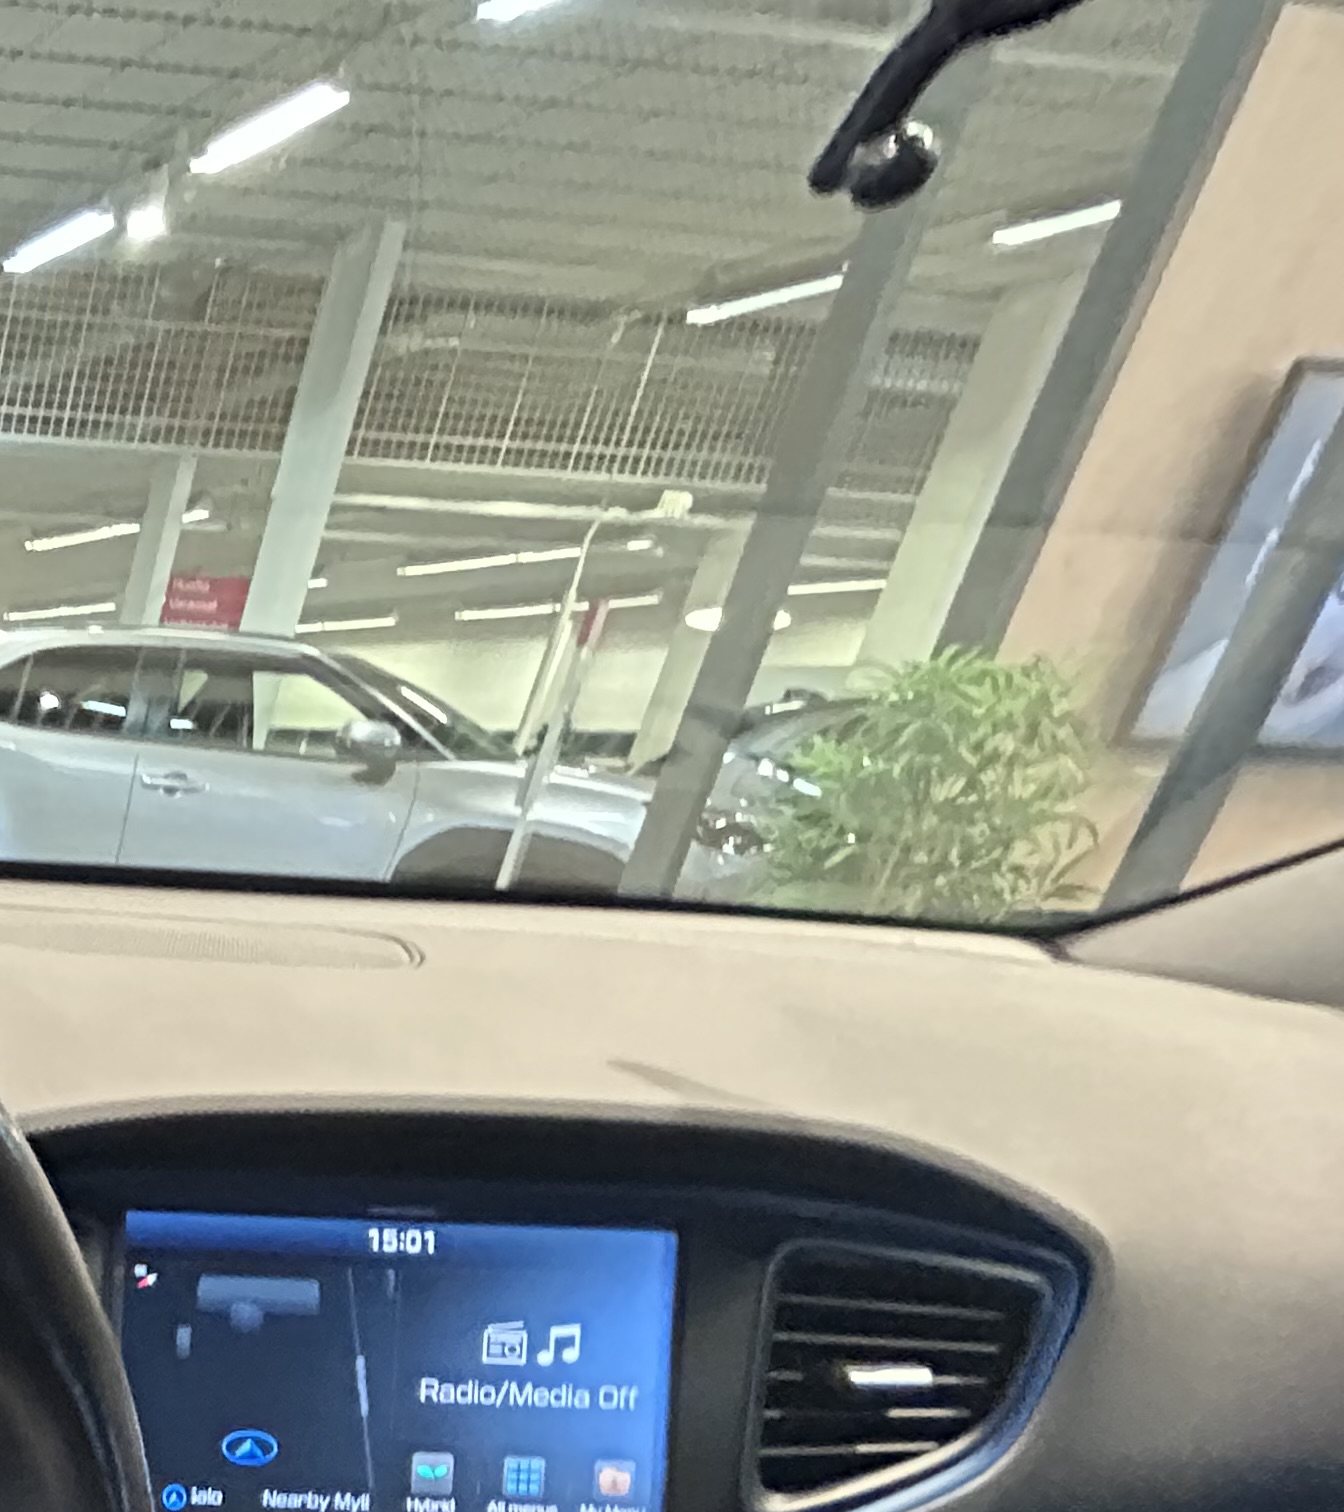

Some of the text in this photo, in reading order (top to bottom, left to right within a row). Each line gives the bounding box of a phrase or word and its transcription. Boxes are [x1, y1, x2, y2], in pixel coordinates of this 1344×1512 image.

[368, 1227, 435, 1255] 15:01
[418, 1376, 640, 1411] Radio/Media Off
